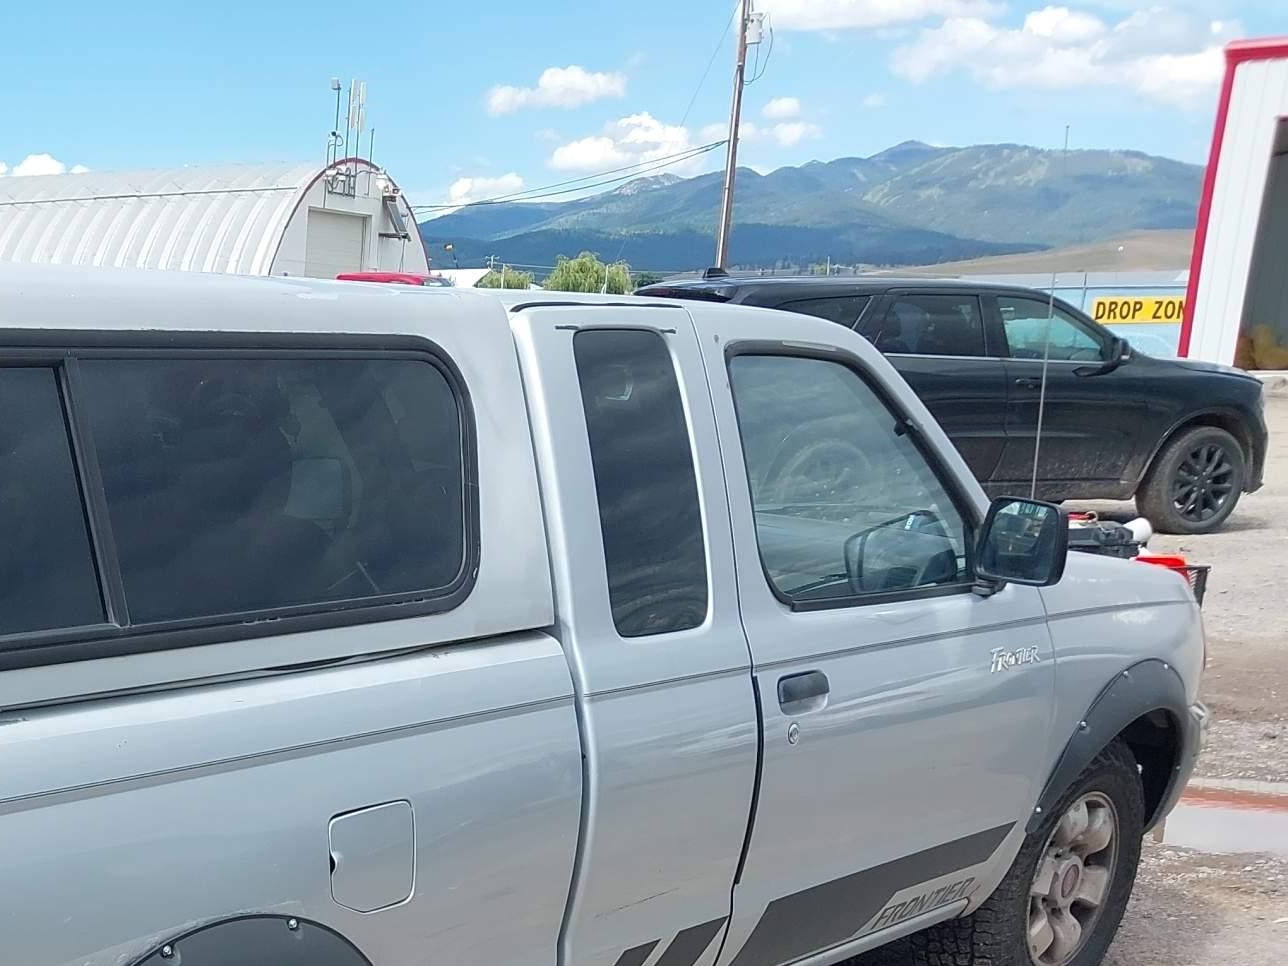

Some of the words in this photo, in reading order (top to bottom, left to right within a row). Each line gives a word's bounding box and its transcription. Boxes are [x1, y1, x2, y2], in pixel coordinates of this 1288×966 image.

[1095, 300, 1143, 320] DROP
[989, 645, 1041, 673] FRONTIER
[871, 877, 977, 930] FRONTIER
